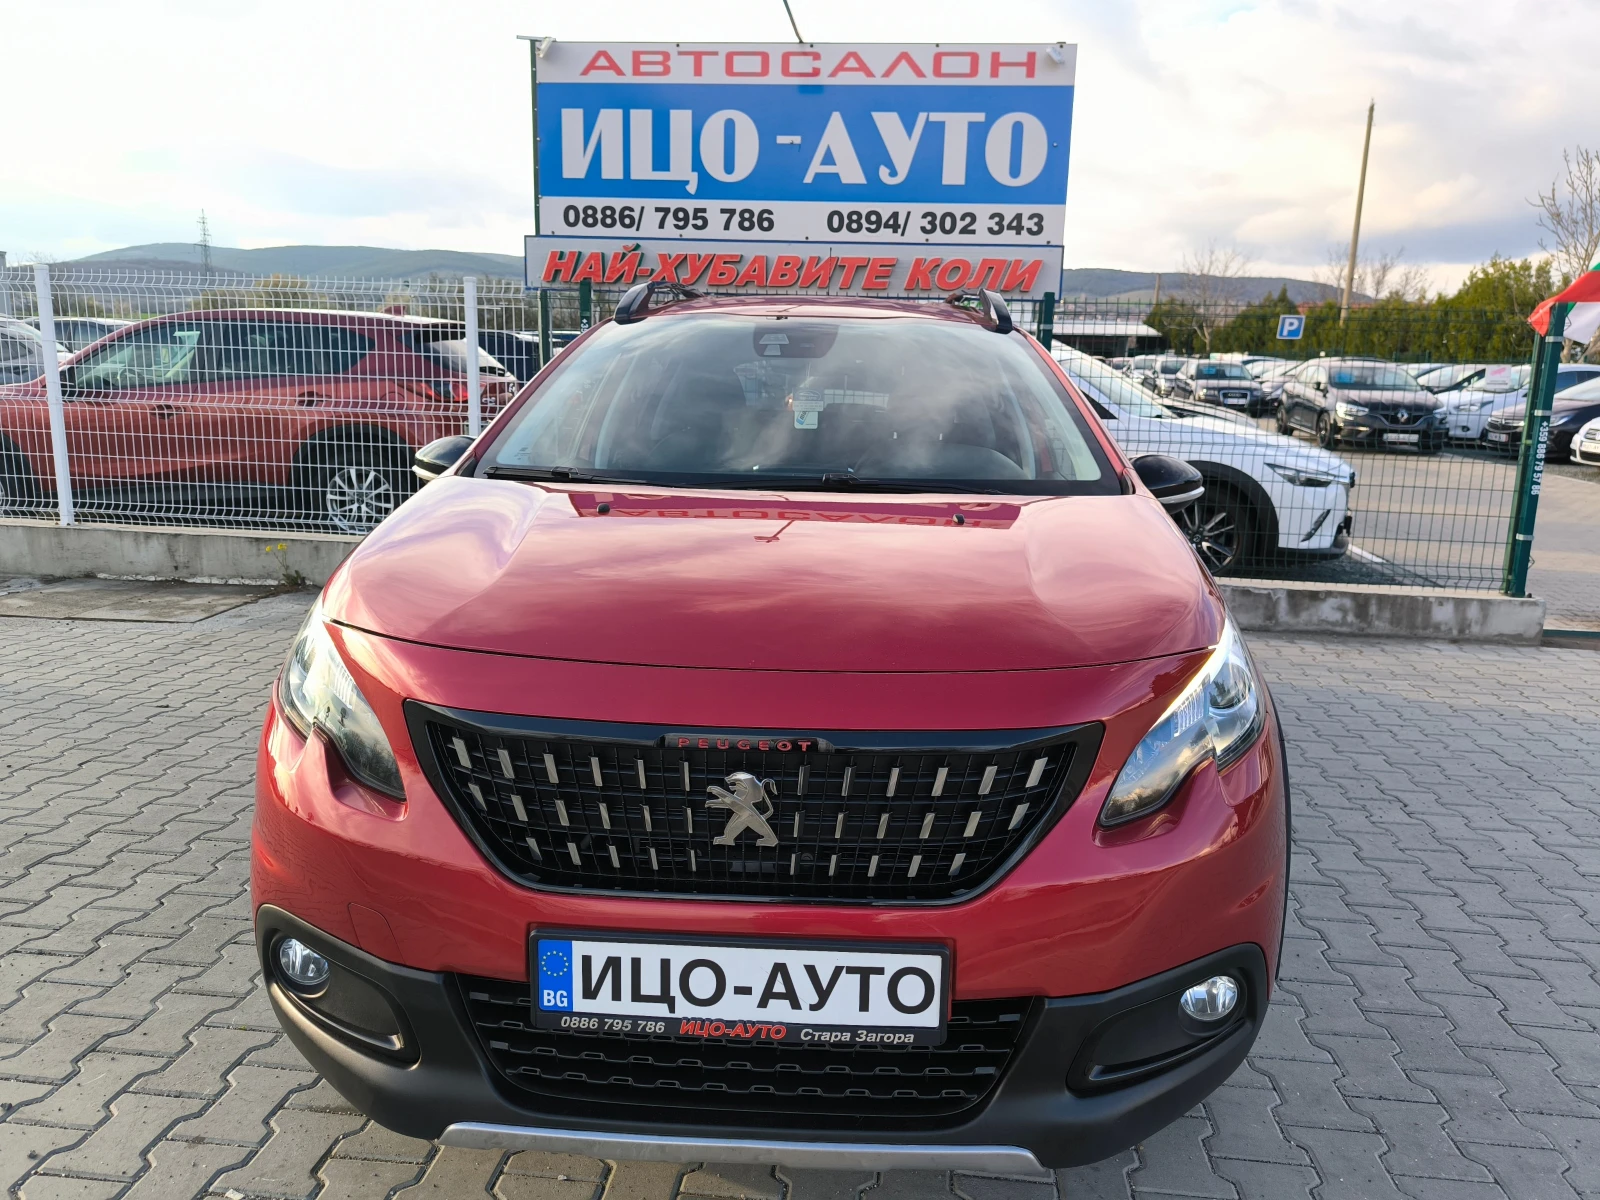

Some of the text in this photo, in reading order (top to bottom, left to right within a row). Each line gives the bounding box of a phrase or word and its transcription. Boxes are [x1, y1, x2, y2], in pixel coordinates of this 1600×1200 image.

[578, 49, 1037, 79] АВТОСАЛОН
[563, 204, 775, 232] 0886/ 795 786
[827, 210, 1044, 236] 0894/ 302 343
[541, 243, 1044, 293] НАЙ-ХУБАВИТЕ КОЛИ
[1282, 318, 1299, 337] P
[1538, 421, 1549, 441] +359
[1536, 443, 1547, 459] 886
[1534, 461, 1545, 471] 79
[677, 737, 812, 752] PEUGEOT
[581, 954, 936, 1015] ИЦО-АУТО
[543, 989, 568, 1007] BG
[560, 1016, 666, 1034] 0886 795 786
[679, 1019, 787, 1040] ИЦО-АУТО
[800, 1028, 915, 1044] Стара Загора
